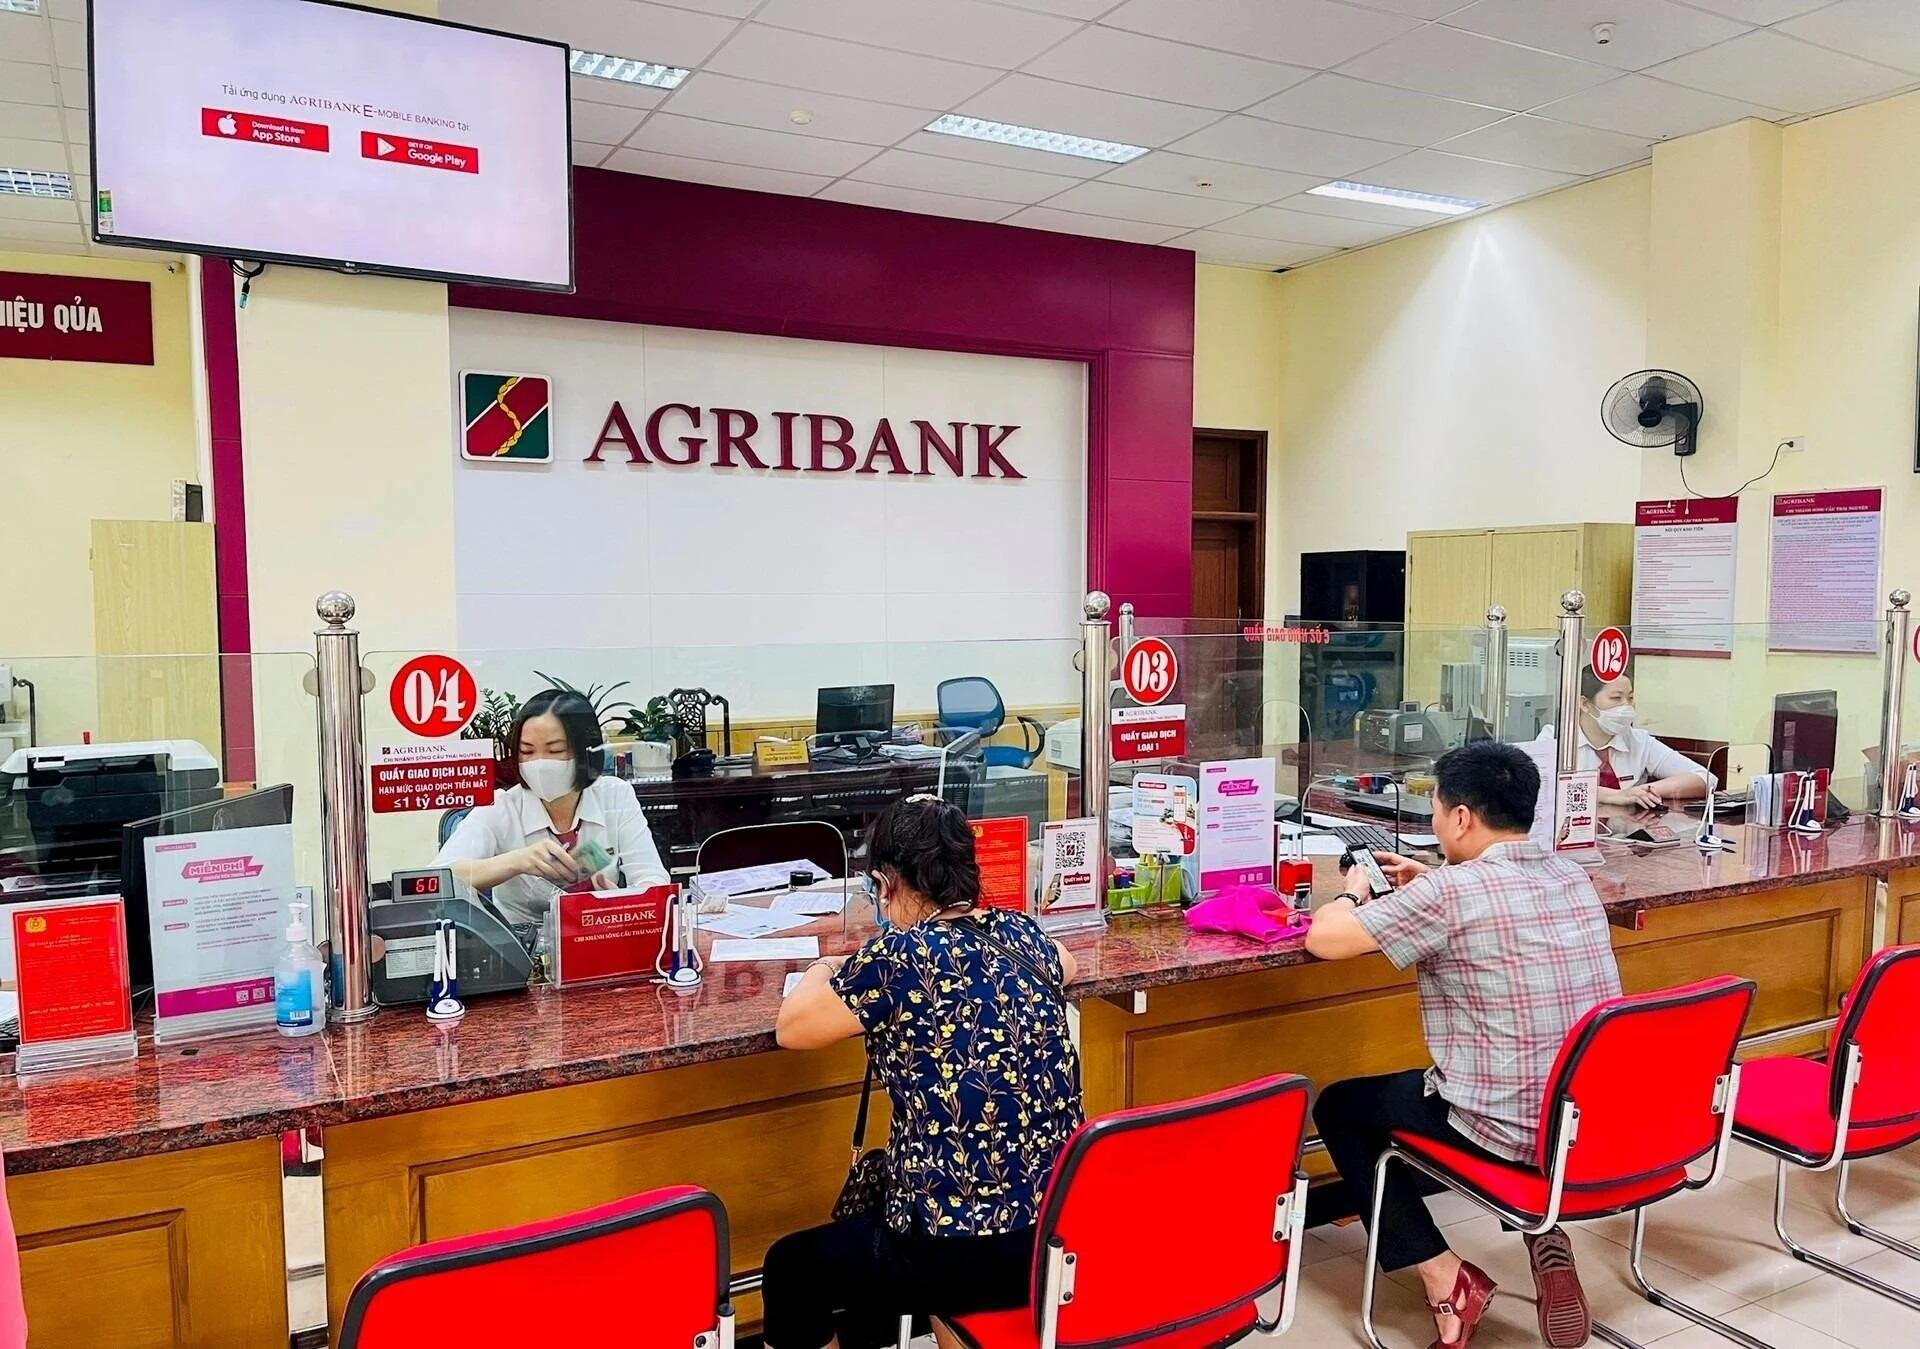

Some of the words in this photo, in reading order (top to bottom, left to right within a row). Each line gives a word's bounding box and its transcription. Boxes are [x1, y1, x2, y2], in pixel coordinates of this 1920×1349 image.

[222, 85, 237, 95] Tải
[240, 87, 258, 100] ứng
[261, 92, 285, 104] dụng
[290, 95, 360, 114] AGRIBANK
[415, 115, 455, 128] BANKING
[252, 121, 284, 131] Download
[252, 129, 273, 141] App
[275, 132, 300, 143] Store
[408, 149, 443, 164] Google
[445, 155, 466, 168] Play
[54, 296, 103, 333] QỦA
[582, 400, 1027, 478] AGRIBANK
[1267, 628, 1285, 642] GIAO
[1310, 624, 1320, 644] SỐ
[1597, 638, 1622, 673] 02
[1130, 650, 1169, 693] 03
[403, 668, 466, 725] 04
[1141, 731, 1158, 739] GIAO
[1160, 730, 1176, 739] DỊCH
[393, 745, 447, 754] AGRIBANK
[1137, 743, 1154, 752] LOẠI
[408, 768, 429, 779] GIAO
[432, 767, 454, 779] DỊCH
[457, 766, 478, 777] LOẠI
[480, 765, 486, 775] 2
[379, 786, 394, 796] HẠN
[396, 784, 413, 793] MỨC
[415, 783, 433, 792] GIAO
[435, 782, 453, 792] DỊCH
[416, 794, 430, 809] tỷ
[435, 792, 474, 806] đồng
[416, 877, 438, 893] 60
[595, 910, 656, 925] AGRIBANK
